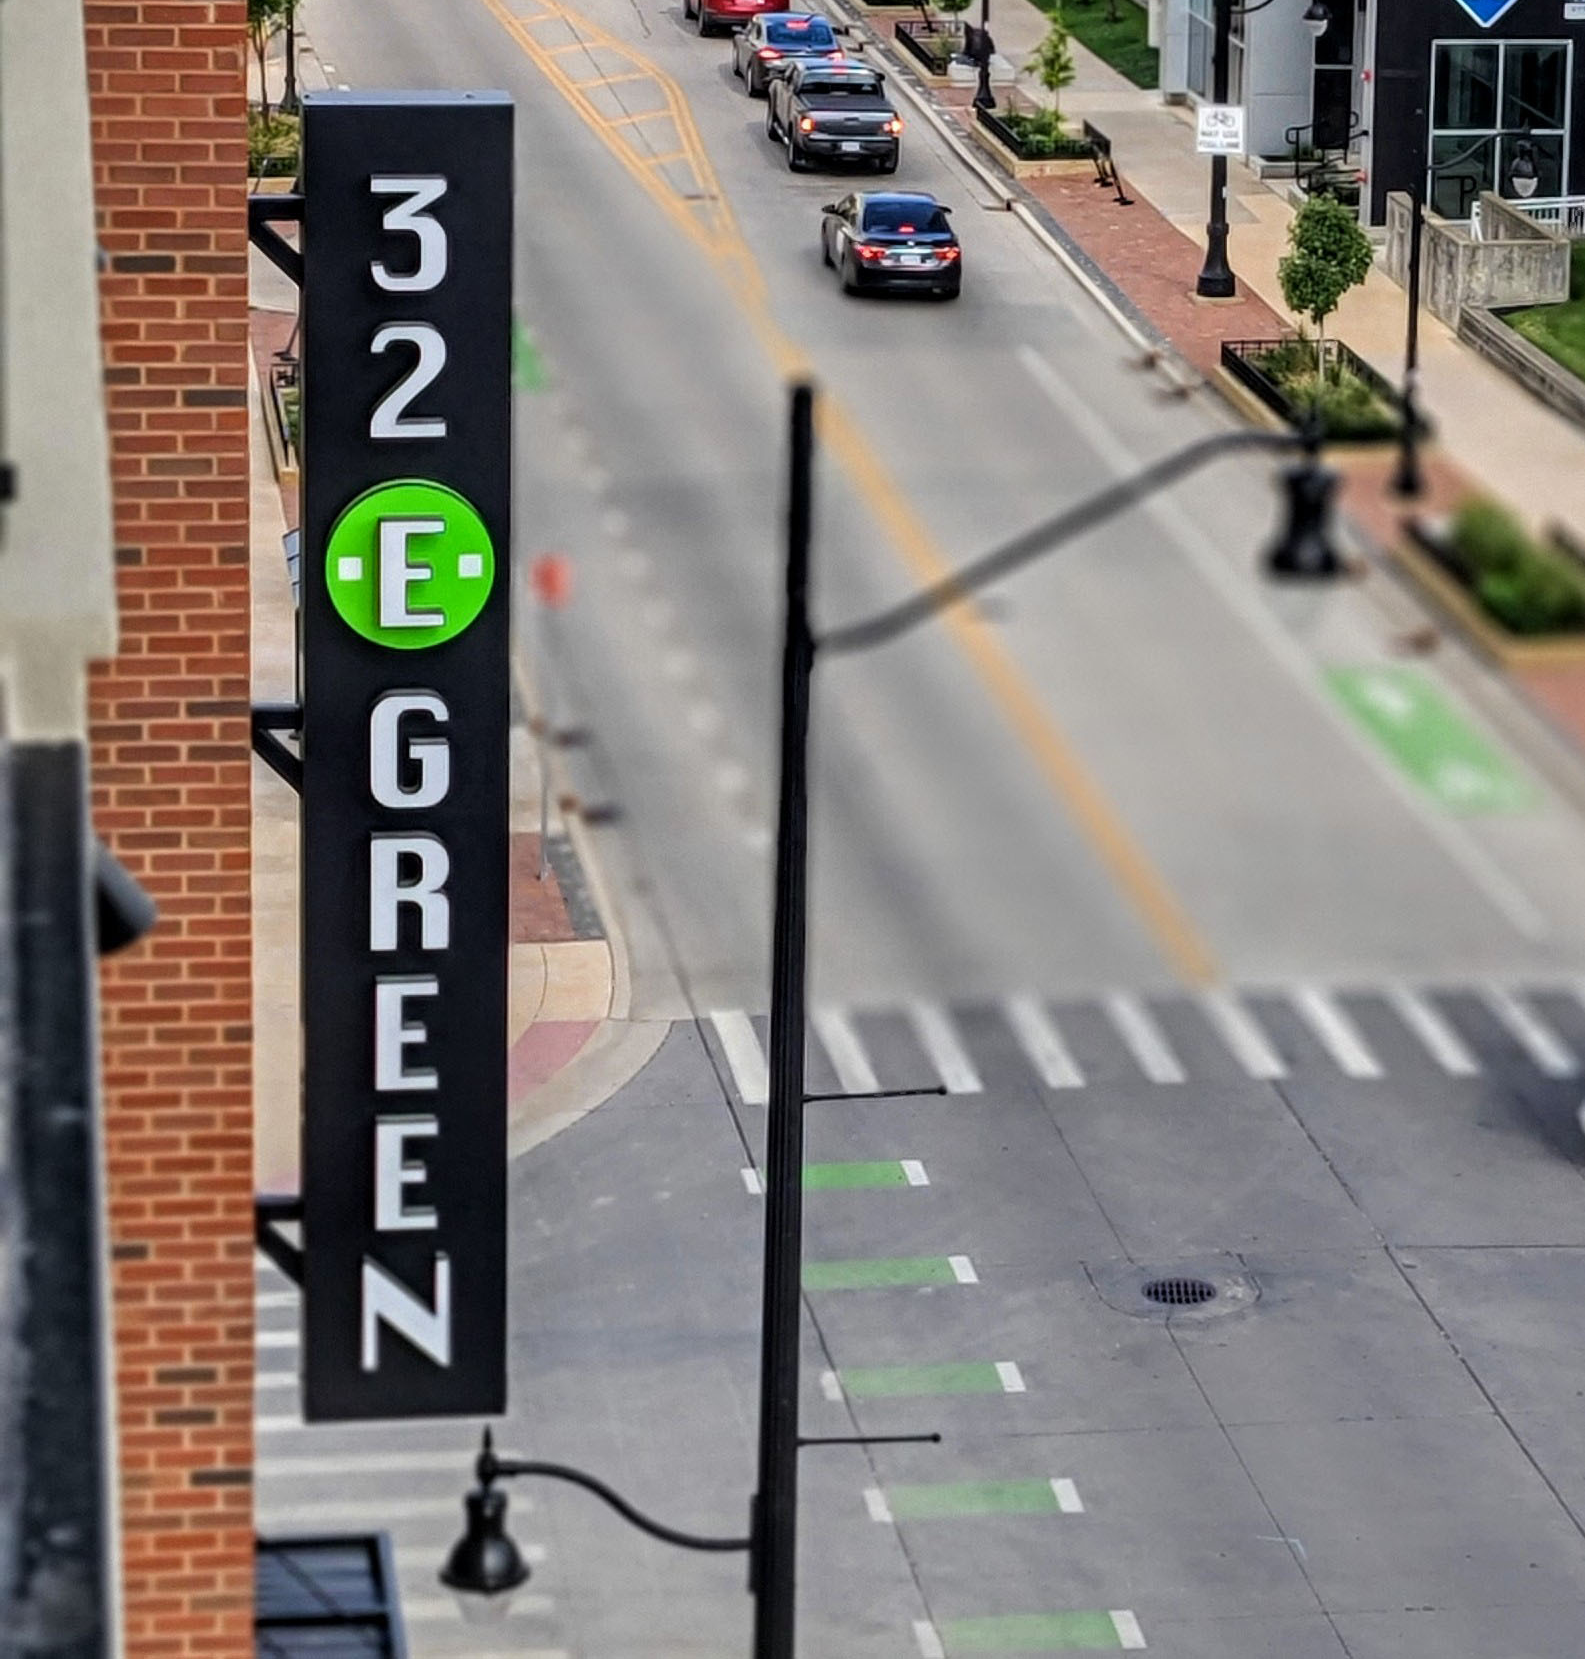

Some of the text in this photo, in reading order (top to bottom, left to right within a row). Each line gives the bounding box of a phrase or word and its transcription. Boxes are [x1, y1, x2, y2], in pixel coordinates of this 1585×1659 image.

[361, 174, 450, 1372] 32 E GREEN
